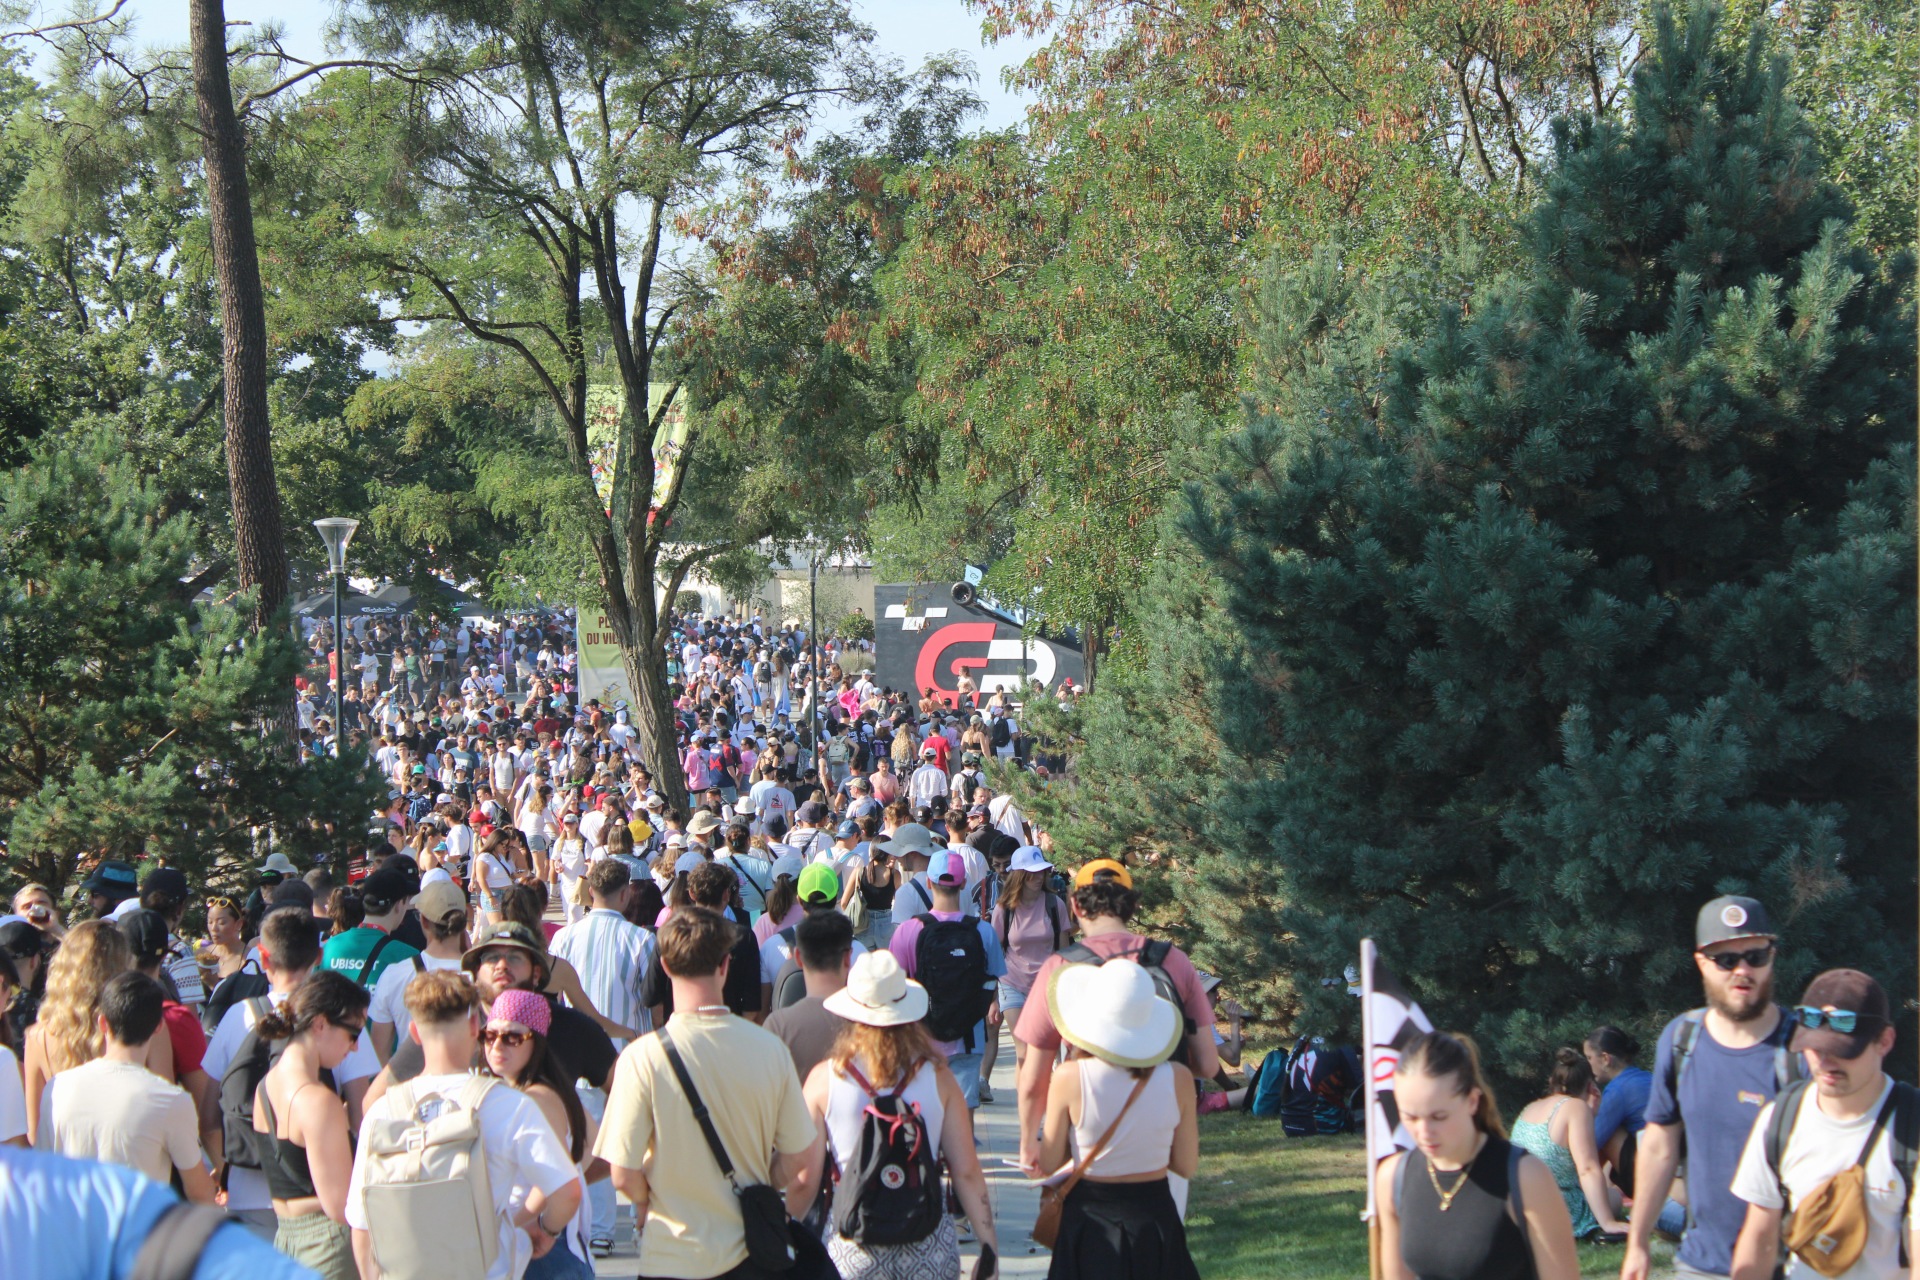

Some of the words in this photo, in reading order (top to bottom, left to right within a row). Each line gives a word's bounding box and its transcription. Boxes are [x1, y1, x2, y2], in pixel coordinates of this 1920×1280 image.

[598, 616, 611, 629] PL
[586, 632, 600, 645] DU
[602, 632, 619, 645] VIL
[330, 957, 379, 971] UBISOT
